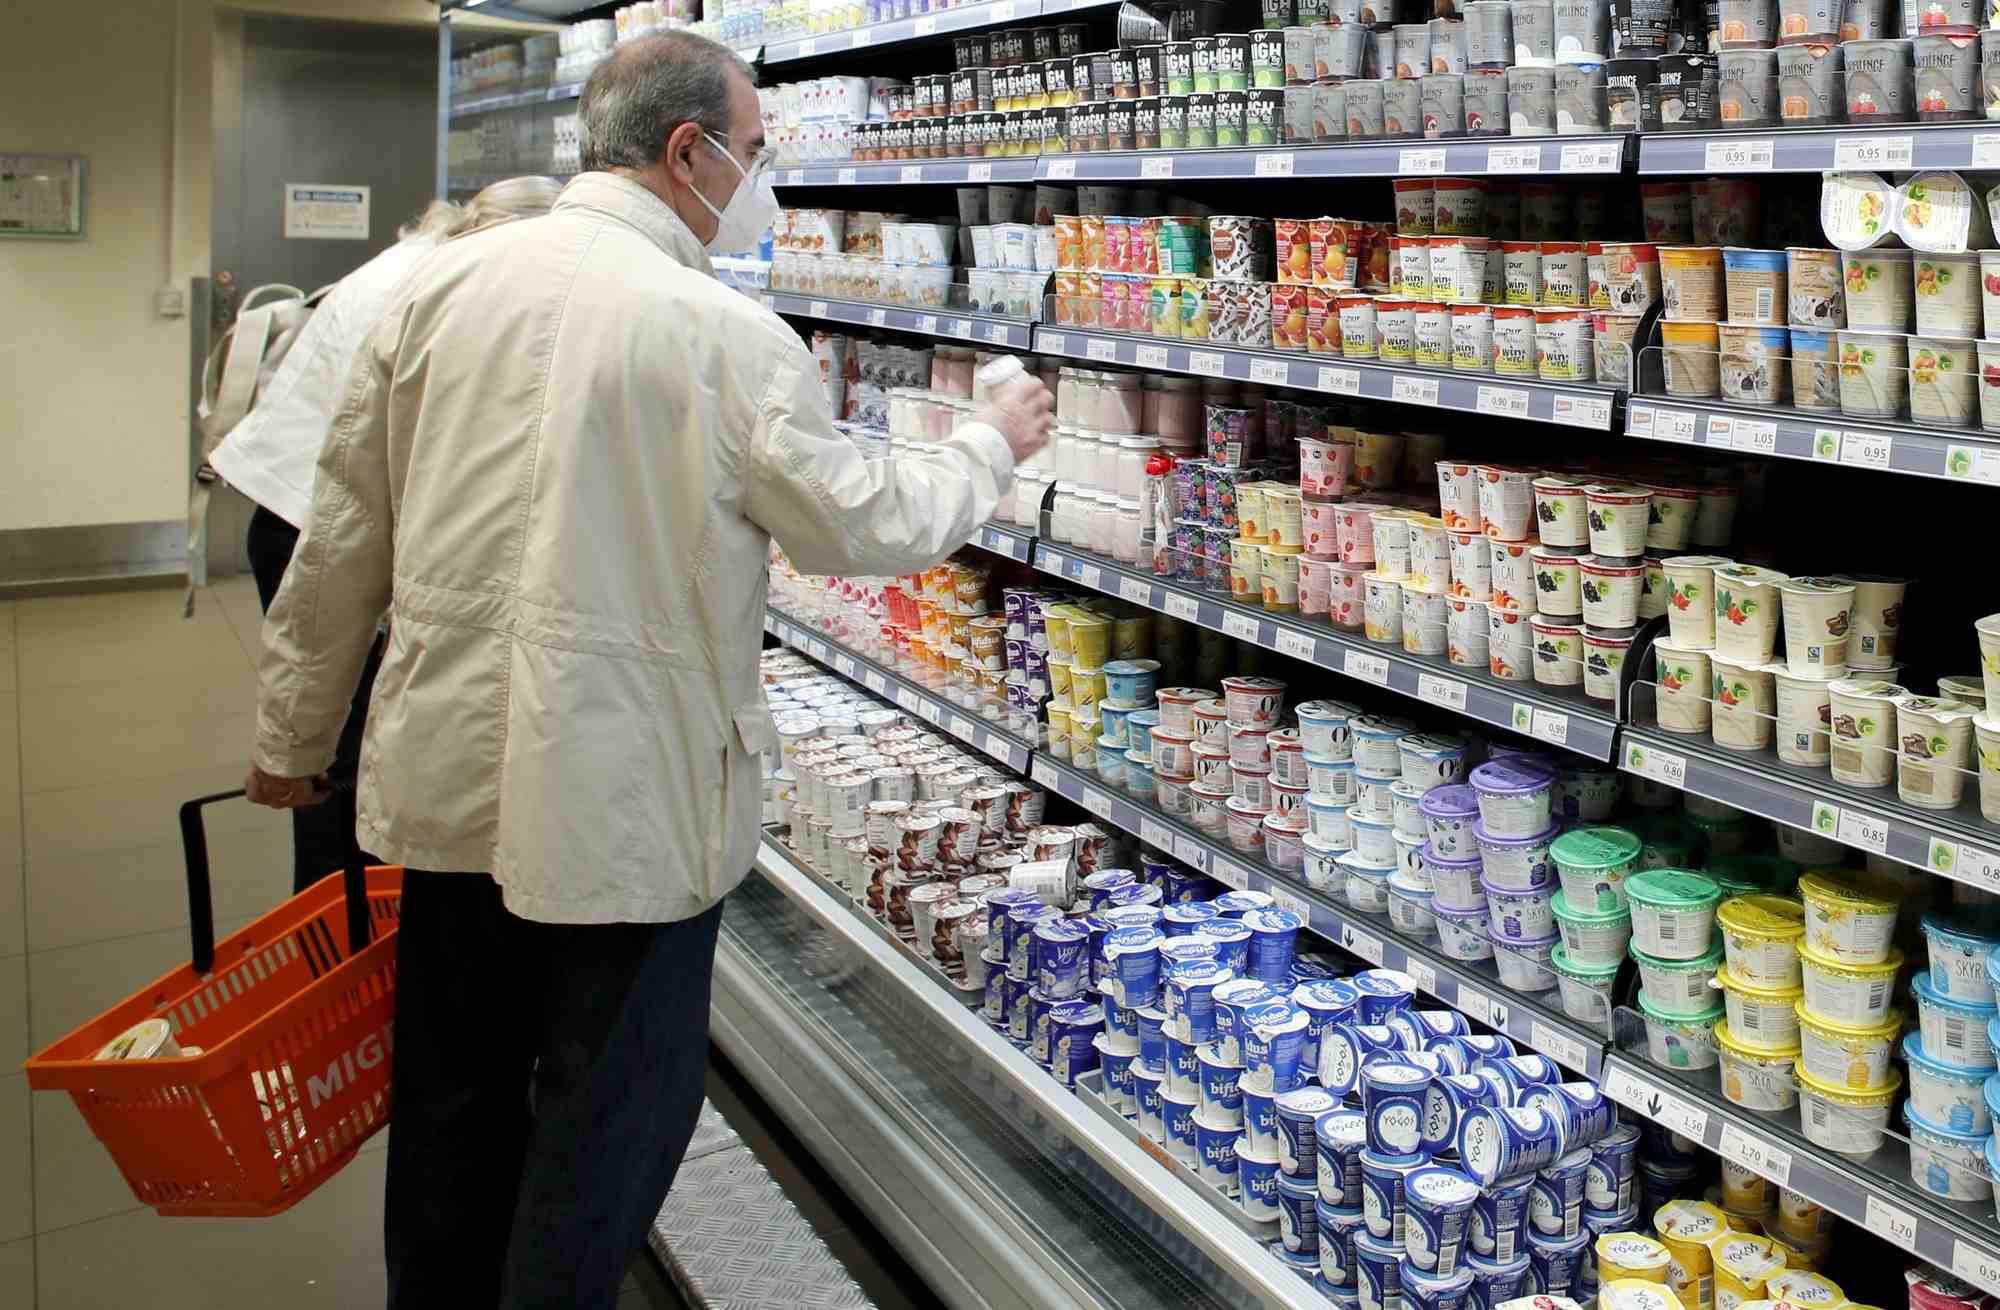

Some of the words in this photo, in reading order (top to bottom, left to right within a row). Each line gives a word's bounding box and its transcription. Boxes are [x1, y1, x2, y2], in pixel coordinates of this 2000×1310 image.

[1725, 152, 1745, 162] 0.95
[1857, 148, 1880, 159] 0.95
[1675, 422, 1692, 433] 1.25
[1754, 432, 1774, 444] 1.05
[1864, 446, 1887, 459] 0.95
[1549, 722, 1565, 735] 0.90
[1664, 764, 1682, 777] 0.80
[1862, 826, 1885, 843] 0.85
[1983, 865, 2000, 880] 0.8
[1955, 959, 1983, 979] SKYR
[1336, 1043, 1348, 1084] YOGOS
[1625, 1085, 1644, 1100] 0.95
[1383, 1114, 1414, 1126] YOGOS
[1428, 1096, 1444, 1139] YOGOS
[1684, 1116, 1703, 1131] 1.50
[1470, 1119, 1486, 1163] YOGOS
[1741, 1144, 1761, 1161] 1.70
[1588, 1175, 1604, 1184] GOS
[1889, 1218, 1912, 1239] 1.70
[1610, 1243, 1650, 1254] YOGOS
[1727, 1243, 1760, 1262] YOGOS
[1980, 1264, 2000, 1281] 0.9
